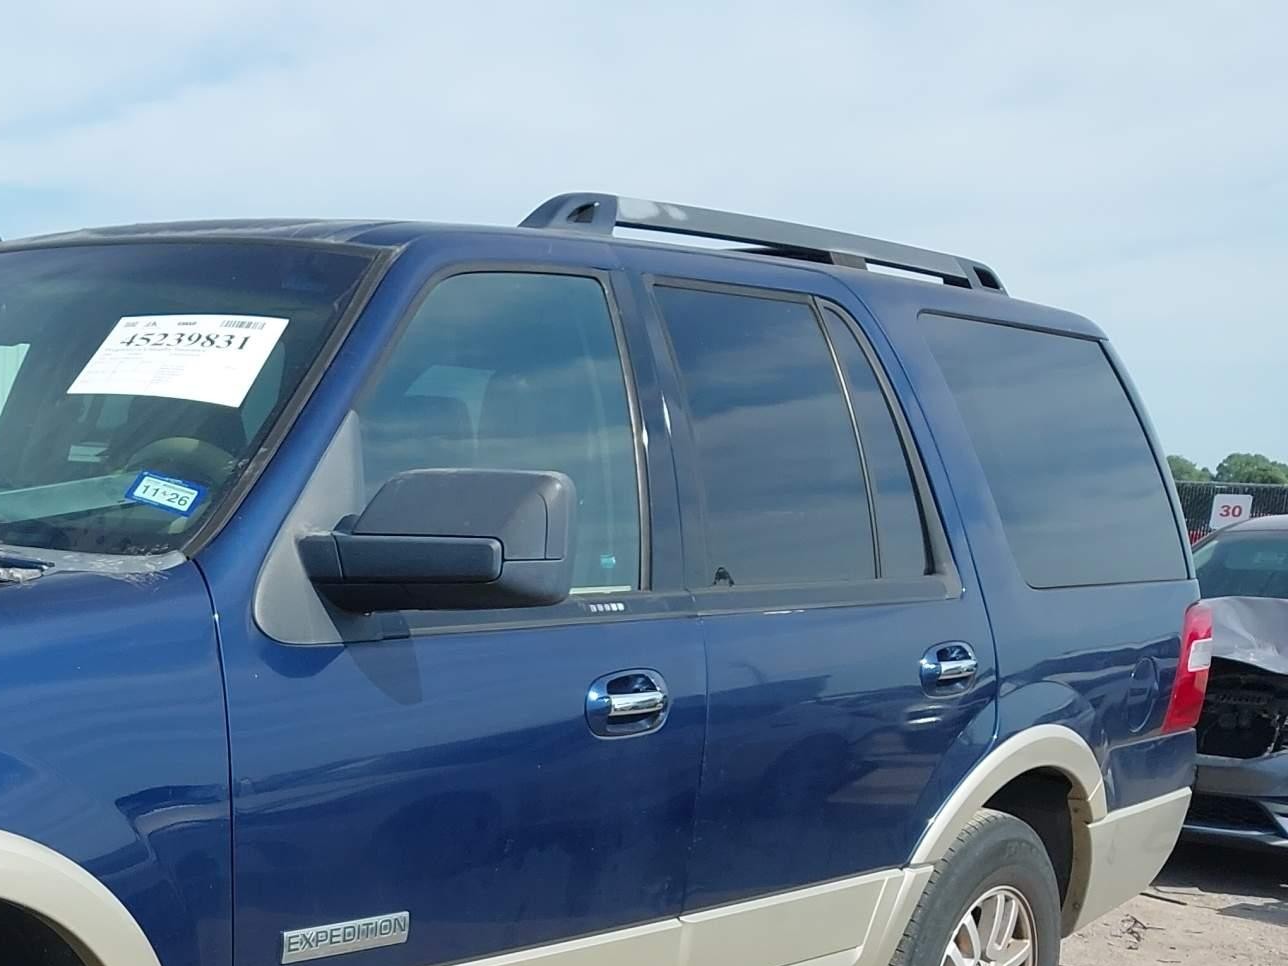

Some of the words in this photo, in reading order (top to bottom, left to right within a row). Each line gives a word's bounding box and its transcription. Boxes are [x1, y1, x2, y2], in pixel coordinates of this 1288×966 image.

[120, 332, 252, 350] 45239831
[142, 484, 160, 497] 11
[167, 492, 190, 506] 26
[1219, 504, 1242, 518] 30
[287, 916, 407, 953] EXPEDITION
